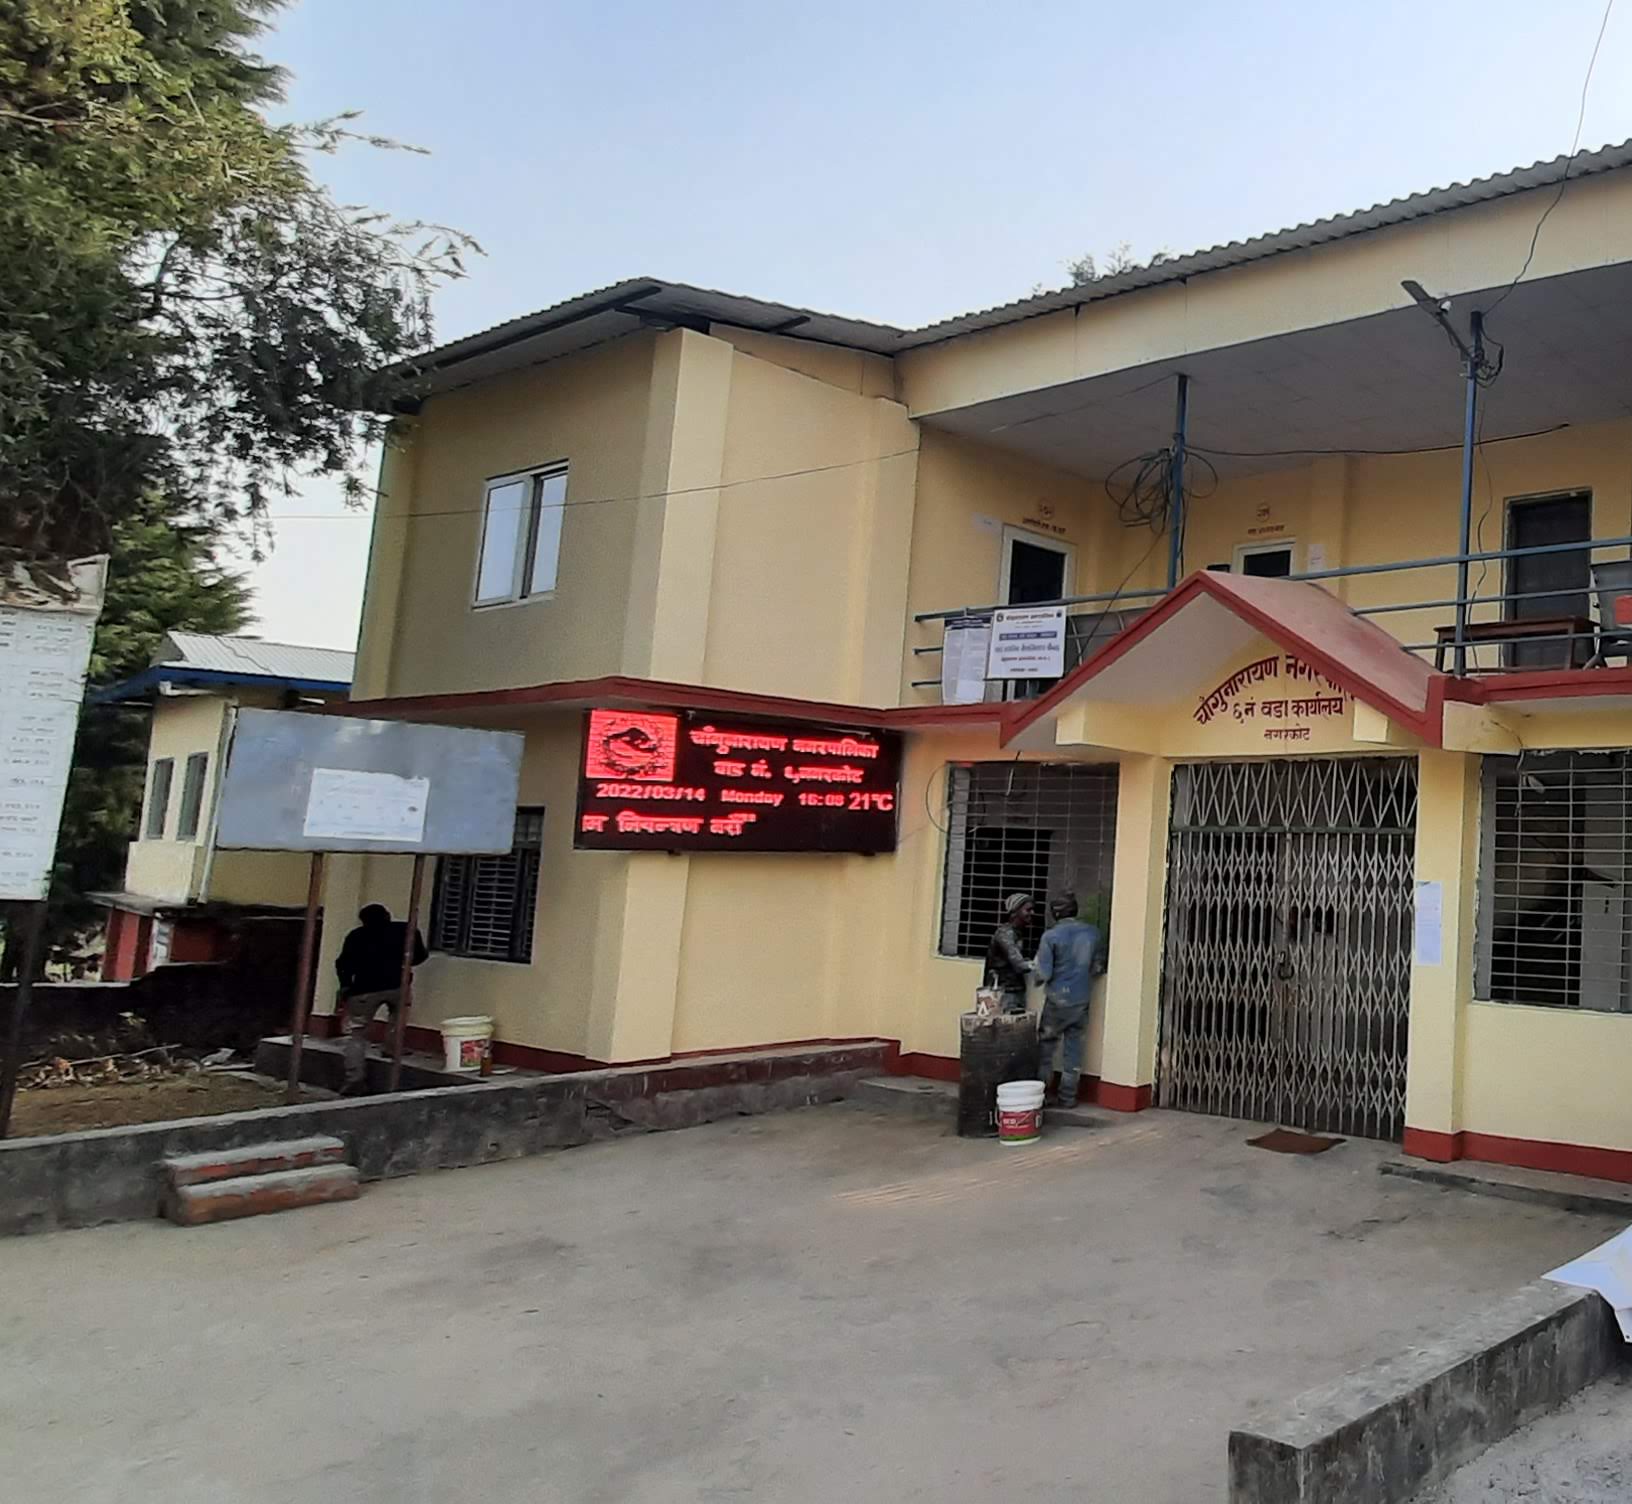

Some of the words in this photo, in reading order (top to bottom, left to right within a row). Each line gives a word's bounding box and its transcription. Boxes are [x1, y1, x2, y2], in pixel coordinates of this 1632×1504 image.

[1261, 699, 1288, 718] वडा
[1291, 691, 1344, 719] कार्यालय
[1264, 723, 1311, 741] नगरकोट
[792, 737, 880, 759] नगरपालिका
[596, 783, 706, 802] 2022/03/14
[721, 789, 784, 807] Monday
